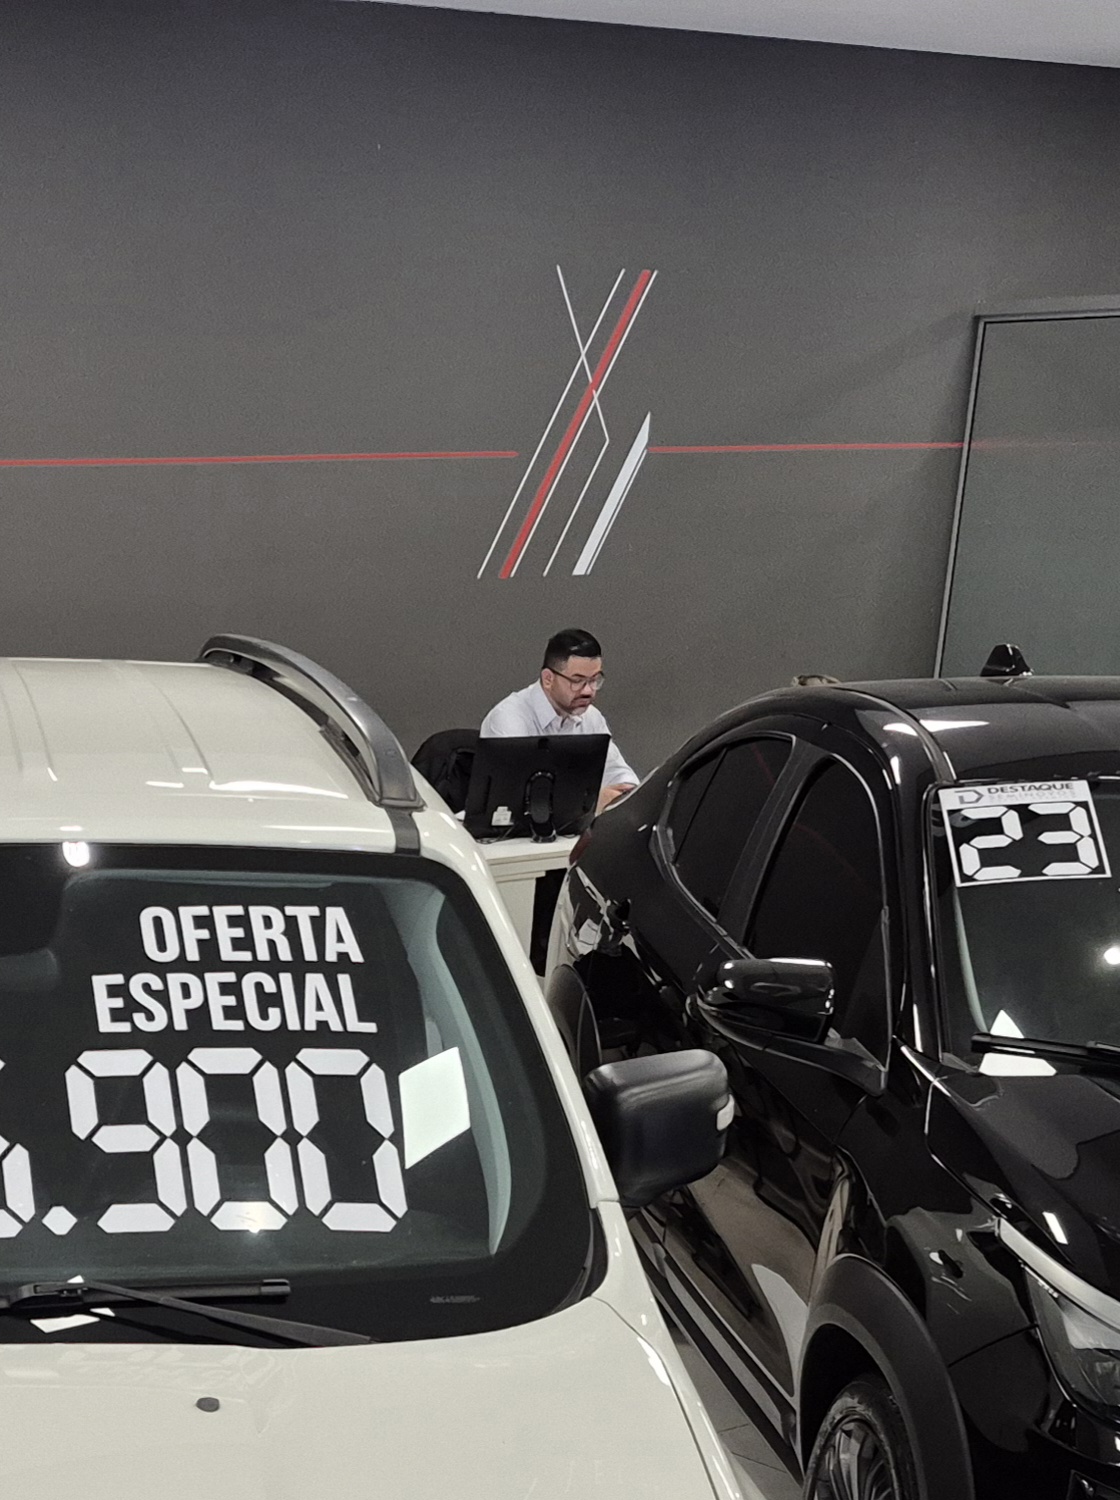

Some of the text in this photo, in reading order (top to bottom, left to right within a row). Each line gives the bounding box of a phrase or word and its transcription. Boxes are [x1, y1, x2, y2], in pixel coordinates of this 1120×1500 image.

[987, 782, 1074, 795] DESTAQUE
[959, 802, 1099, 880] 23
[139, 905, 365, 963] OFERTA
[91, 972, 378, 1033] ESPECIAL
